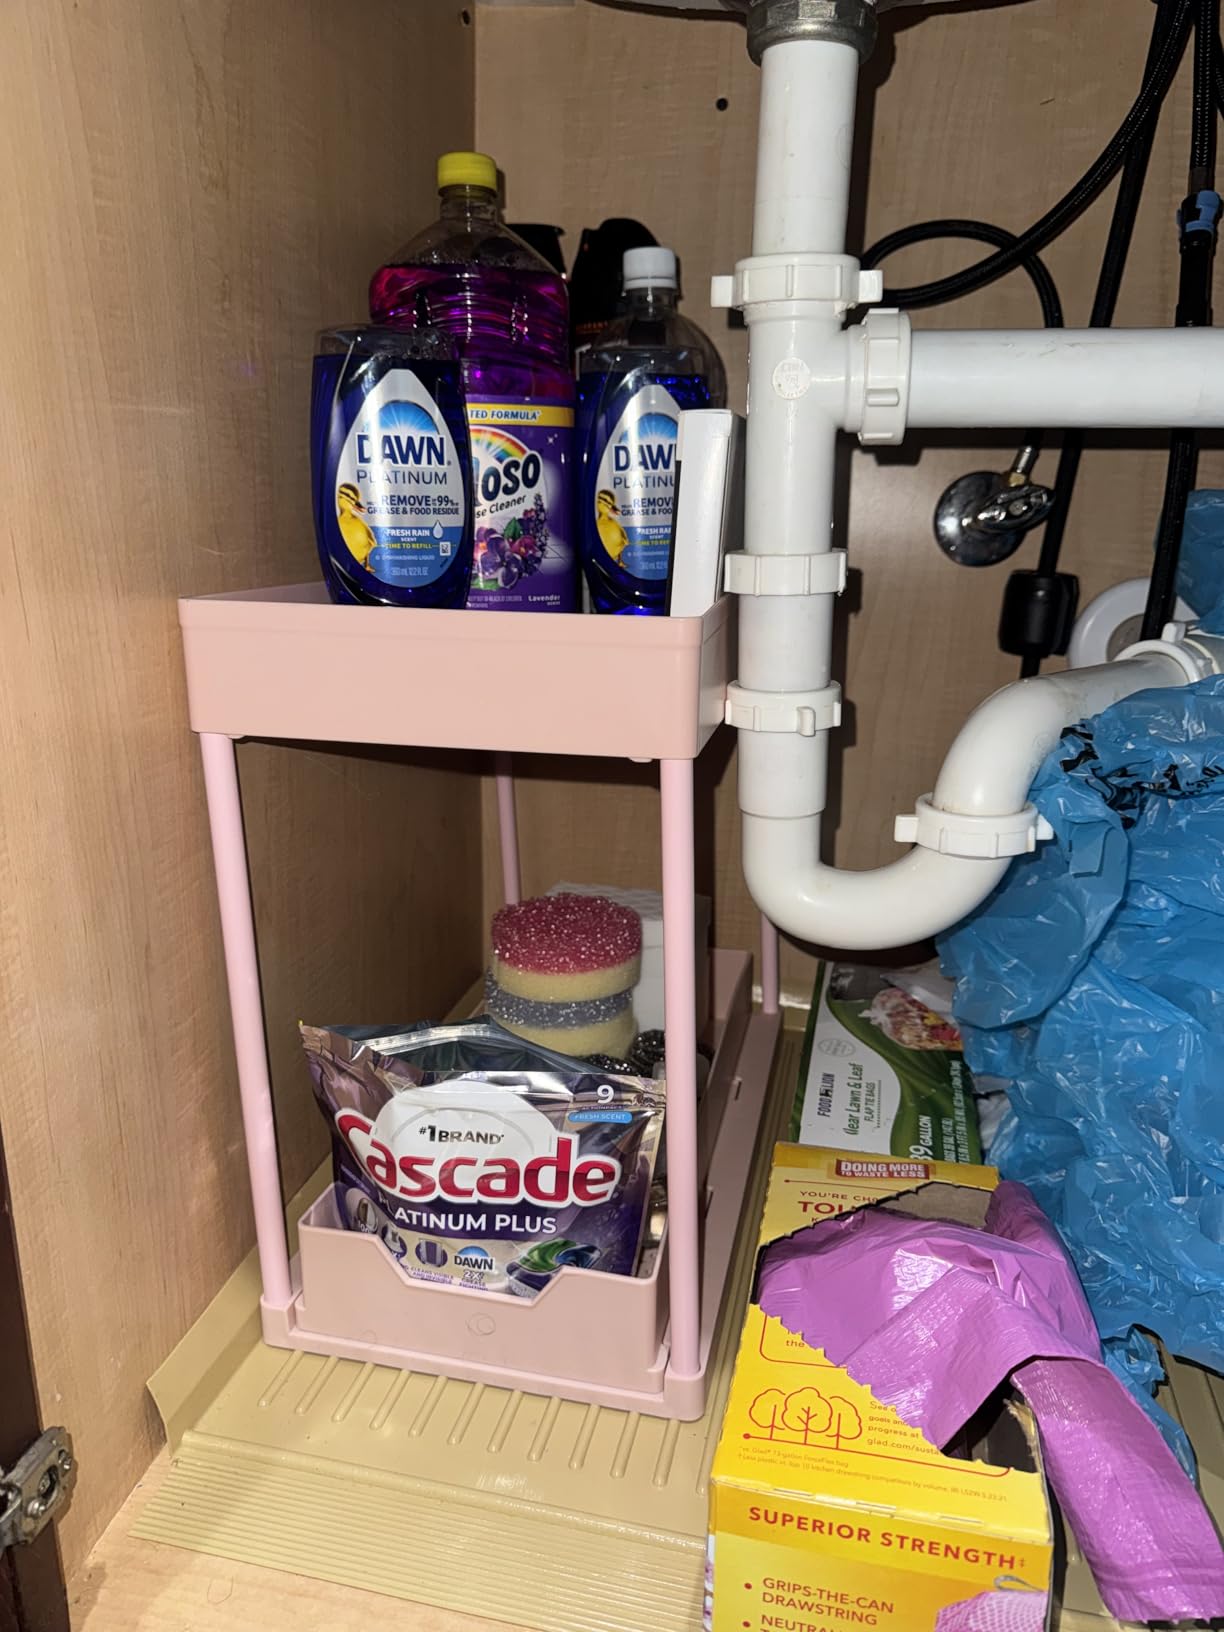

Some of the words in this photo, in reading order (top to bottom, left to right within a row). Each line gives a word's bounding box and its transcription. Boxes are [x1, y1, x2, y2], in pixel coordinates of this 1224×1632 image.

[470, 409, 488, 419] TED
[356, 434, 445, 466] DAWN
[357, 469, 447, 486] PLATINUM
[381, 495, 431, 506] REMOVE
[475, 509, 487, 518] se
[489, 495, 527, 514] Cleaner
[633, 497, 674, 508] REMOV
[410, 507, 431, 515] FOOD
[432, 507, 459, 515] RESIDUE
[528, 594, 561, 602] Lavender
[848, 1063, 863, 1081] Leaf
[821, 1072, 835, 1092] LION
[596, 1084, 614, 1104] 9
[845, 1090, 862, 1113] Lawn
[817, 1097, 831, 1117] FOOD
[864, 1106, 875, 1123] FLAP
[419, 1125, 437, 1142] #1
[919, 1115, 933, 1146] GALLON
[841, 1161, 887, 1172] DOING
[889, 1162, 925, 1173] MORE
[799, 1190, 848, 1200] YOU'RE
[394, 1207, 486, 1232] ATINUM
[494, 1213, 557, 1234] PLUS
[454, 1255, 493, 1270] DAWN
[869, 1400, 888, 1411] See
[868, 1425, 908, 1436] progress
[867, 1438, 940, 1456] glad.com/susta
[748, 1506, 872, 1543] SUPERIOR
[763, 1577, 894, 1614] GRIPS-THE-CAN
[762, 1591, 878, 1626] DRAWSTRING
[761, 1614, 840, 1632] NEUTRA
